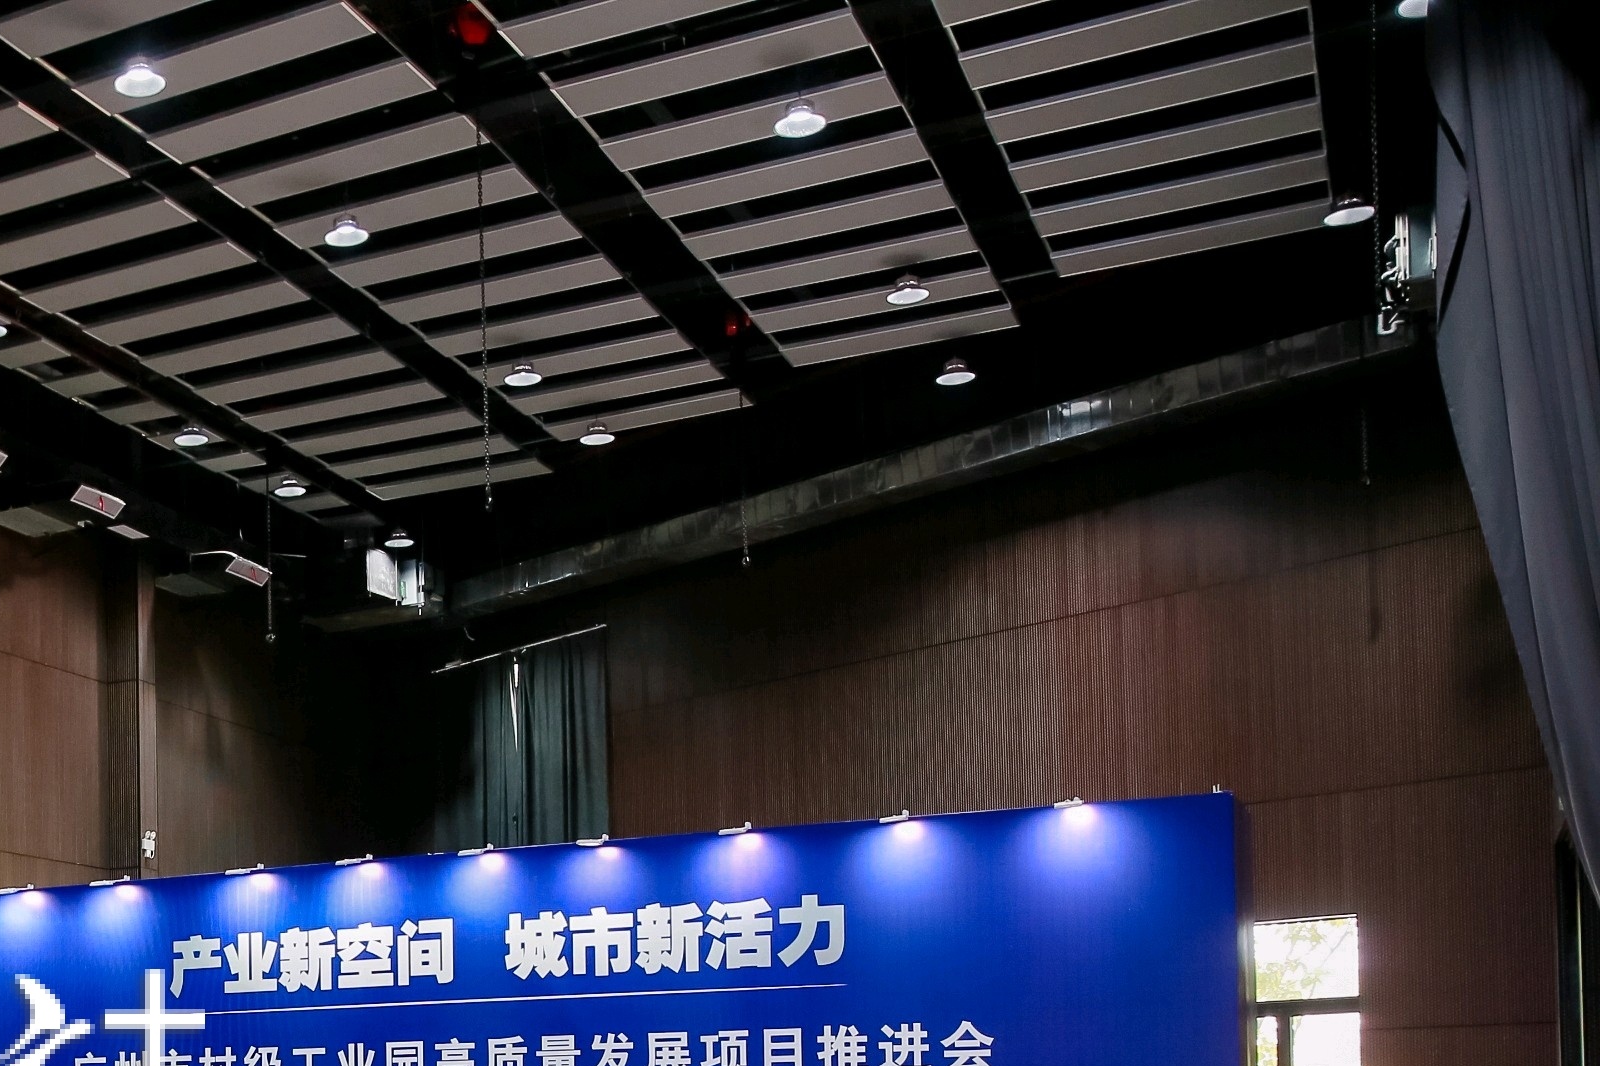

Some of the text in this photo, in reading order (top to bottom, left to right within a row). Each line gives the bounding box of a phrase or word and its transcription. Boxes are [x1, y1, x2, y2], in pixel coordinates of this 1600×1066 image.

[170, 895, 846, 998] 产业新空间 城市新活力
